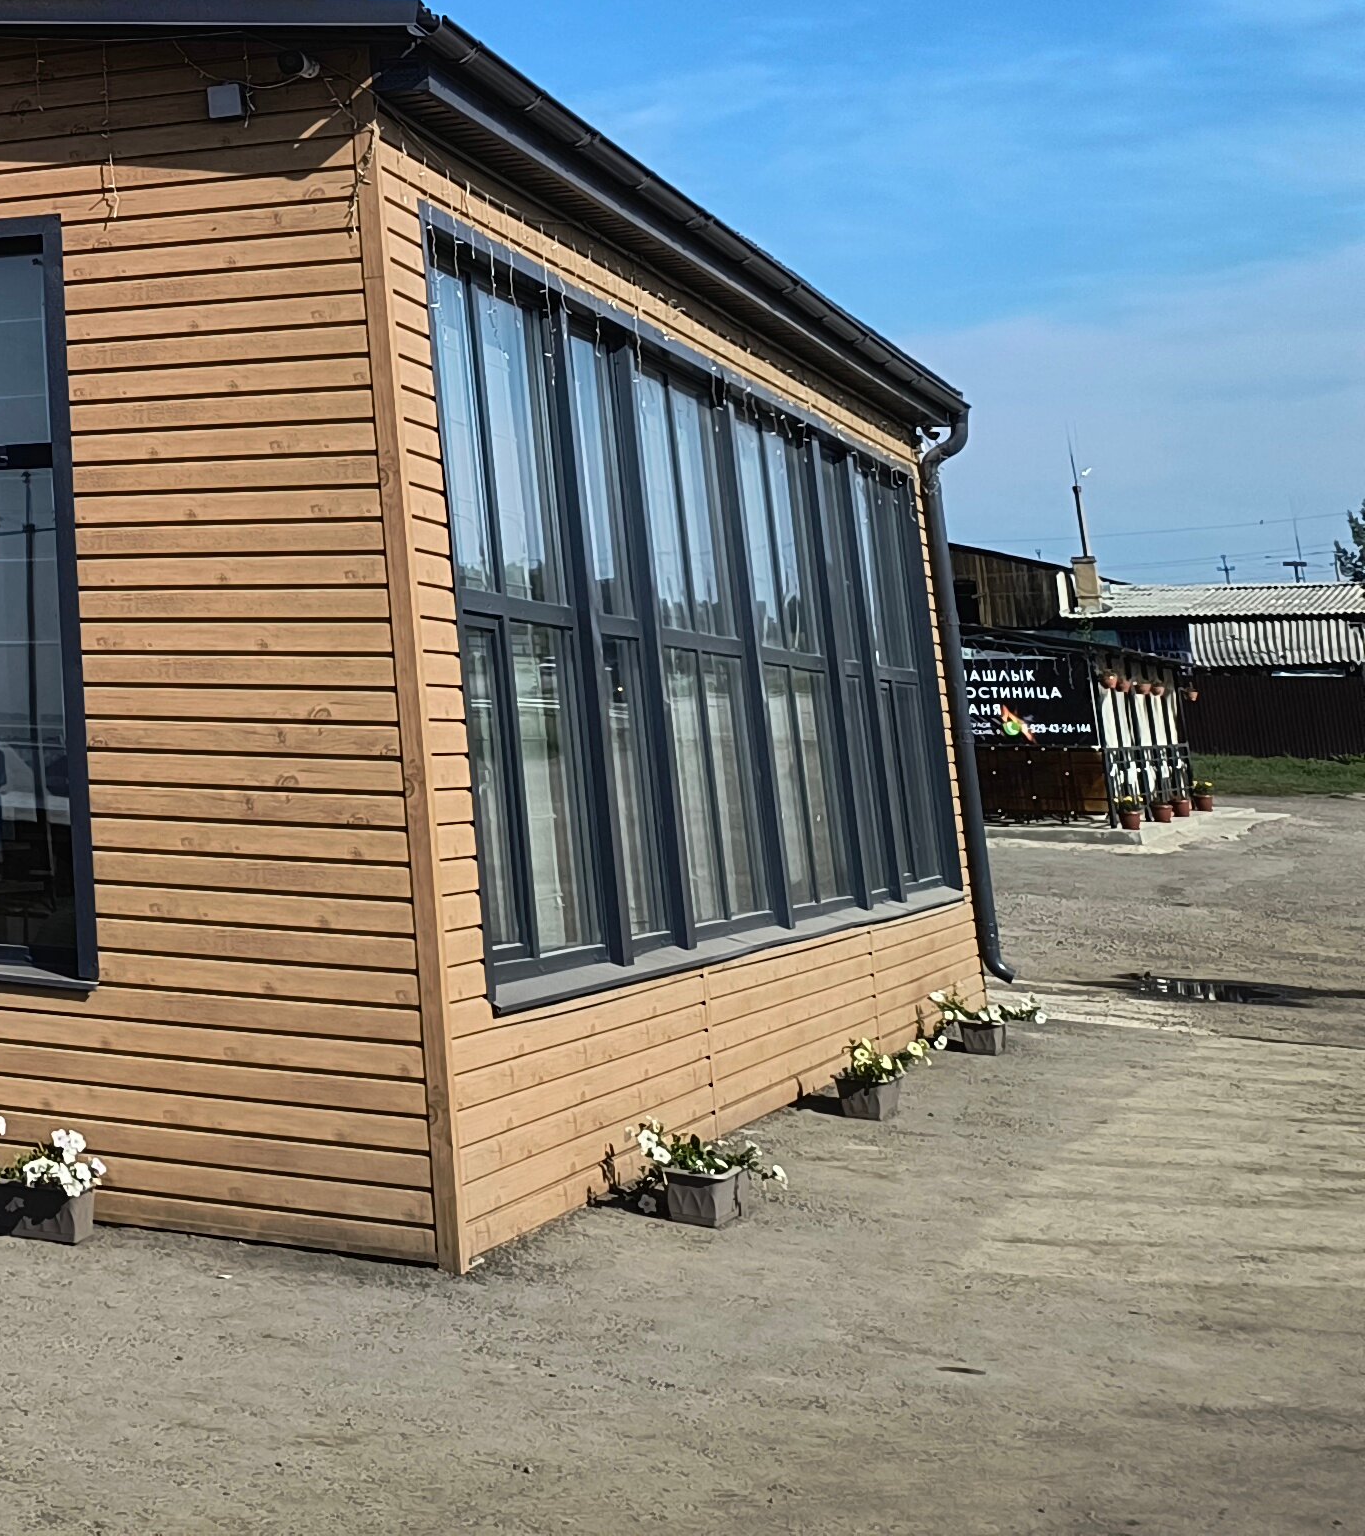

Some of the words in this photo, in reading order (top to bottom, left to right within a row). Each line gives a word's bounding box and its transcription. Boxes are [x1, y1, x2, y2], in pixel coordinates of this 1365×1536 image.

[964, 670, 1035, 682] АШЛЫК
[966, 686, 1062, 700] ОСТИНИЦА
[969, 704, 1002, 716] АНЯ
